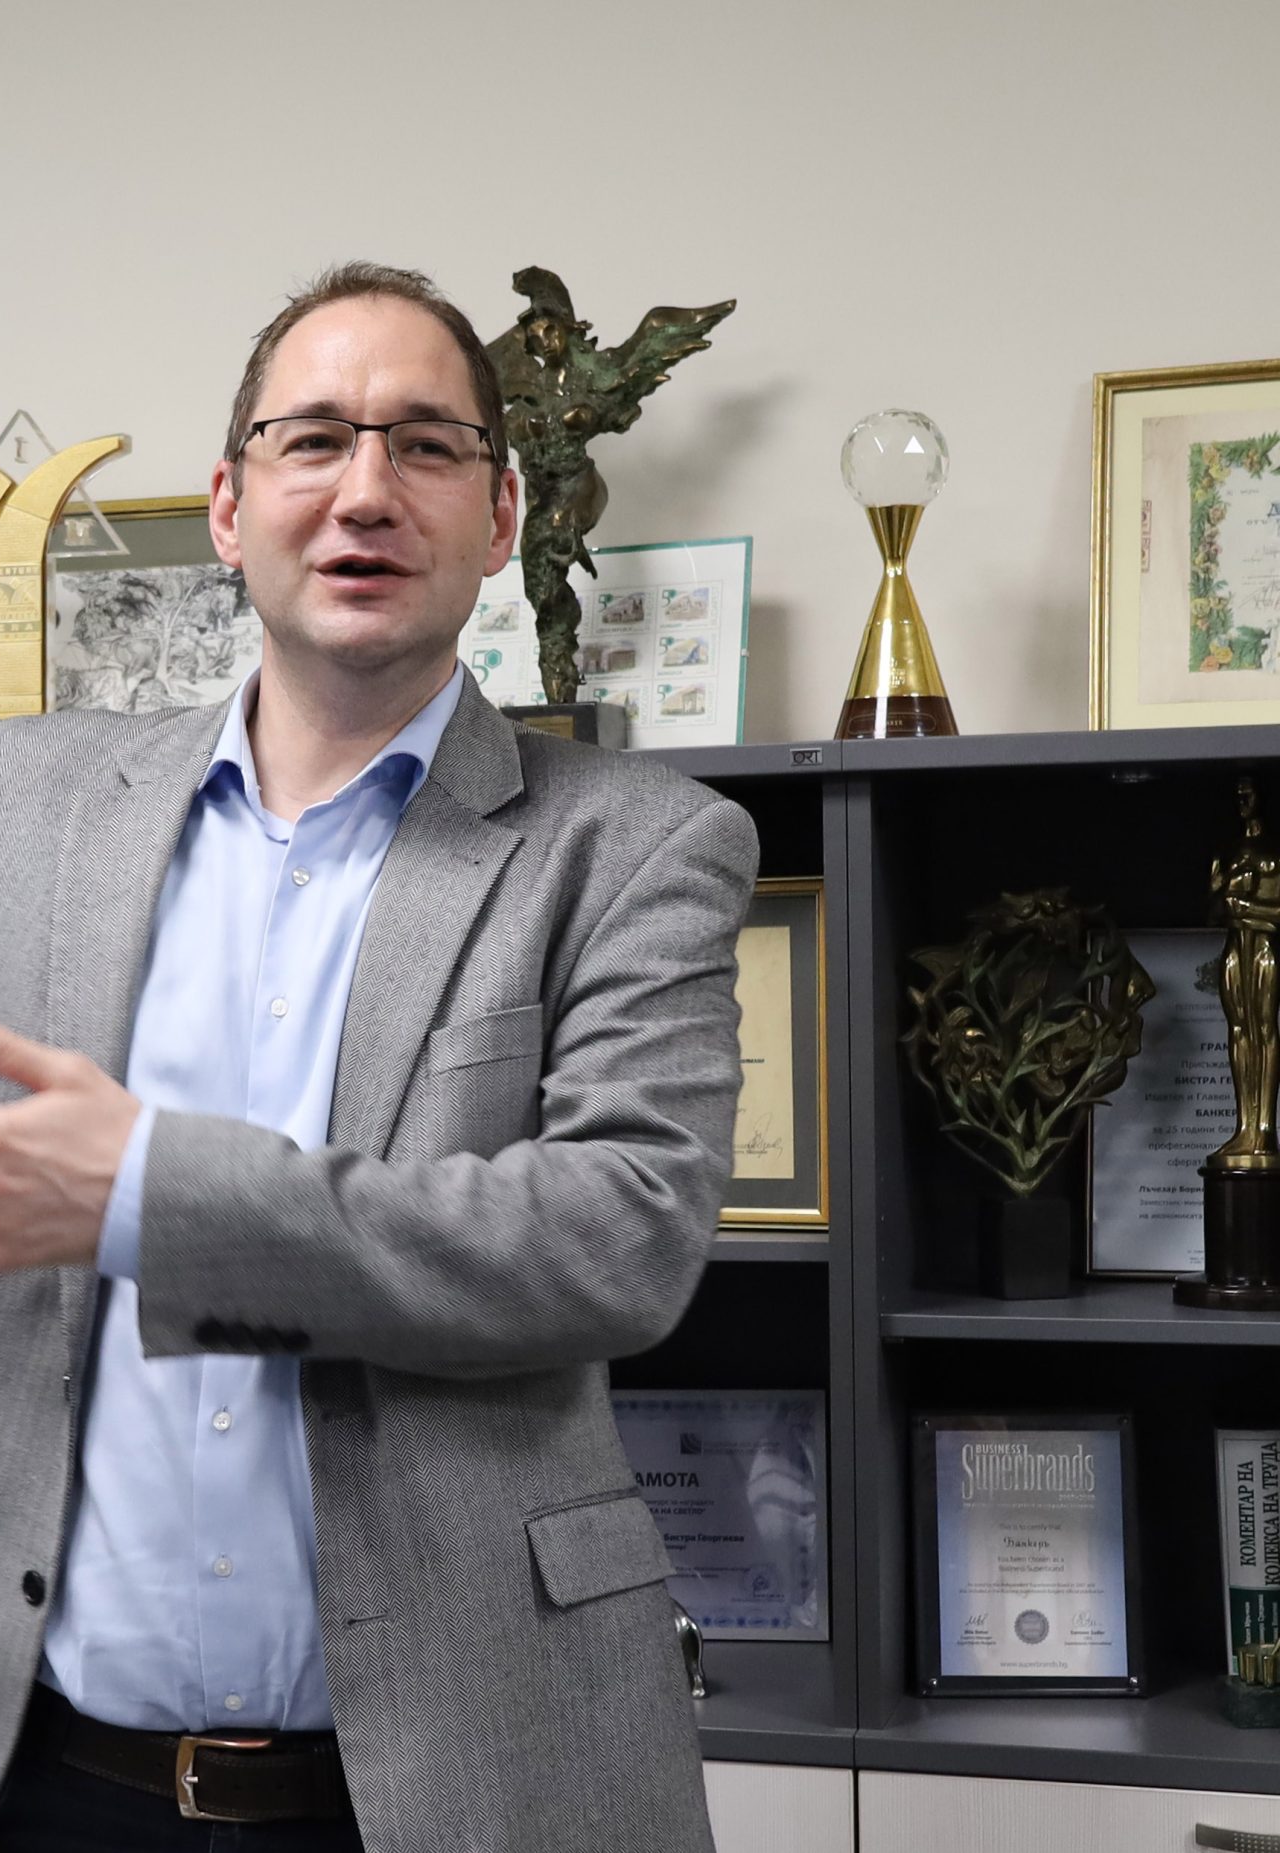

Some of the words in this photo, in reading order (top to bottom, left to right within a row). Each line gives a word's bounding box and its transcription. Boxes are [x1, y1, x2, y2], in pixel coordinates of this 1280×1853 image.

[975, 1443, 1021, 1455] BUSINESS
[1260, 1441, 1279, 1490] ТРУДА
[635, 1471, 699, 1488] АМОТА
[961, 1443, 1096, 1501] Superbrands
[1237, 1460, 1254, 1483] НА
[1262, 1492, 1280, 1514] НА
[1239, 1485, 1257, 1567] КОМЕНТАР
[1263, 1518, 1280, 1587] КОДЕКСА
